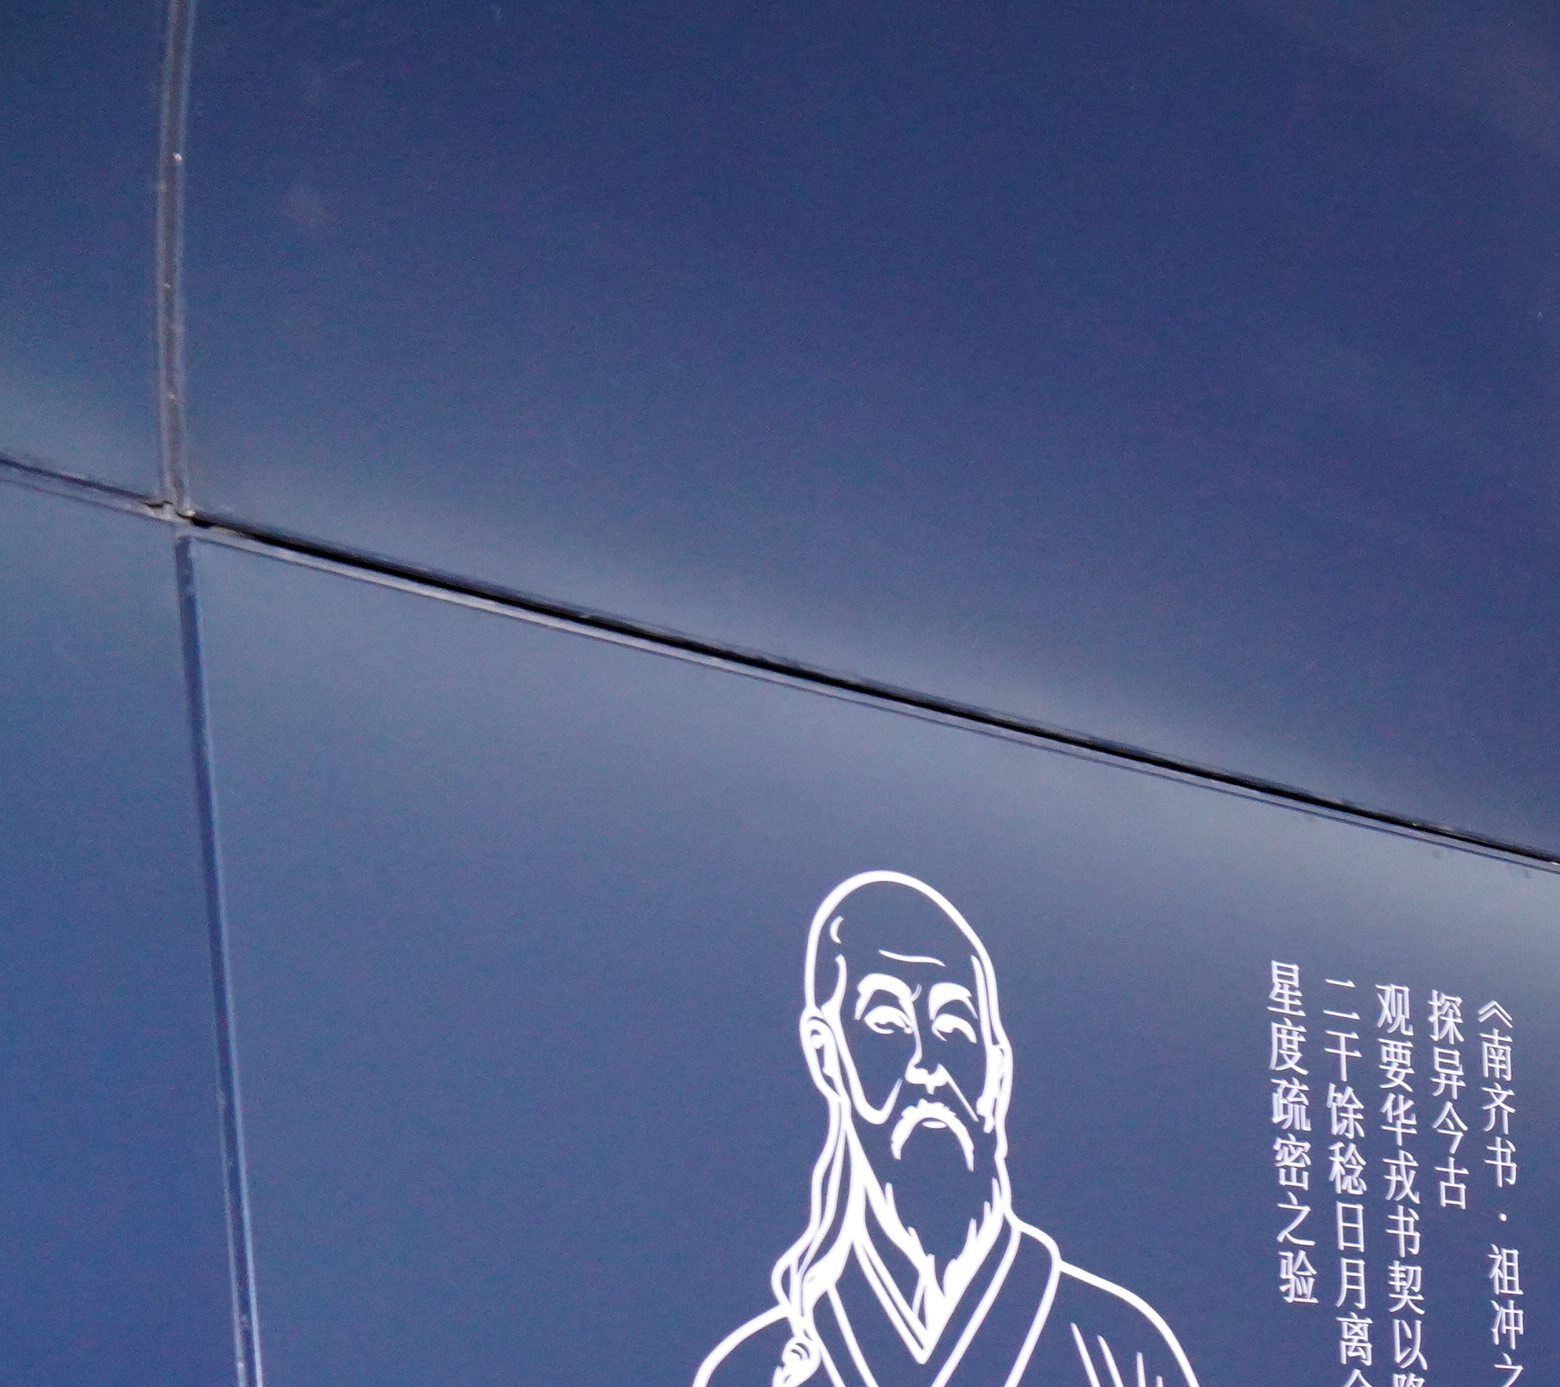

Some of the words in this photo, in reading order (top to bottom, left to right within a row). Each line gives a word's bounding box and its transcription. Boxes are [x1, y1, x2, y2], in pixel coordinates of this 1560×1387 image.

[1267, 959, 1318, 1305] 星度疏密之验
[1427, 988, 1469, 1210] 探异今古
